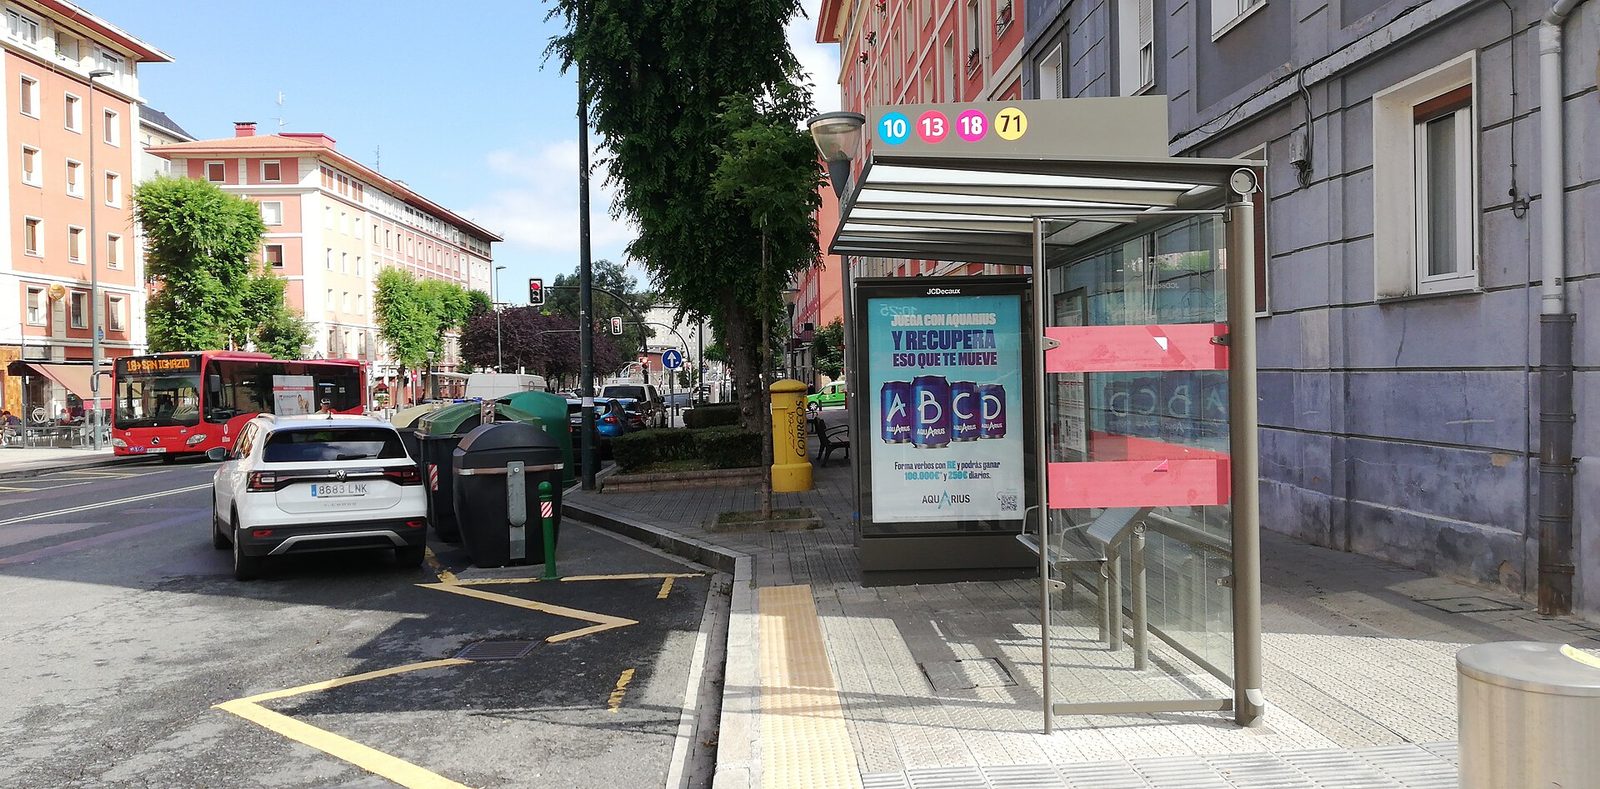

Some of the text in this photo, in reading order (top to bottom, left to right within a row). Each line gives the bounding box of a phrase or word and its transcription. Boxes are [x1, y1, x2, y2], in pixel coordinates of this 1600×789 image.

[883, 115, 1021, 138] 10 13 18 71
[891, 312, 997, 328] JUEGA CON AQUARIUS
[891, 329, 997, 351] Y RECUPERA
[126, 358, 190, 372] 18 SAN IGNAZIO
[893, 352, 998, 369] ESO QUE TE MUEVE
[886, 390, 1002, 424] A B C D
[916, 426, 946, 439] AQUARIUS
[894, 461, 914, 470] Forma
[914, 461, 935, 470] verbos
[947, 461, 956, 469] RE
[982, 462, 1001, 471] ganar
[943, 473, 948, 481] y
[948, 471, 968, 480] 250€
[968, 471, 991, 479] diarios.
[318, 484, 367, 495] 8683 LNK
[922, 490, 971, 510] AQUARIUS
